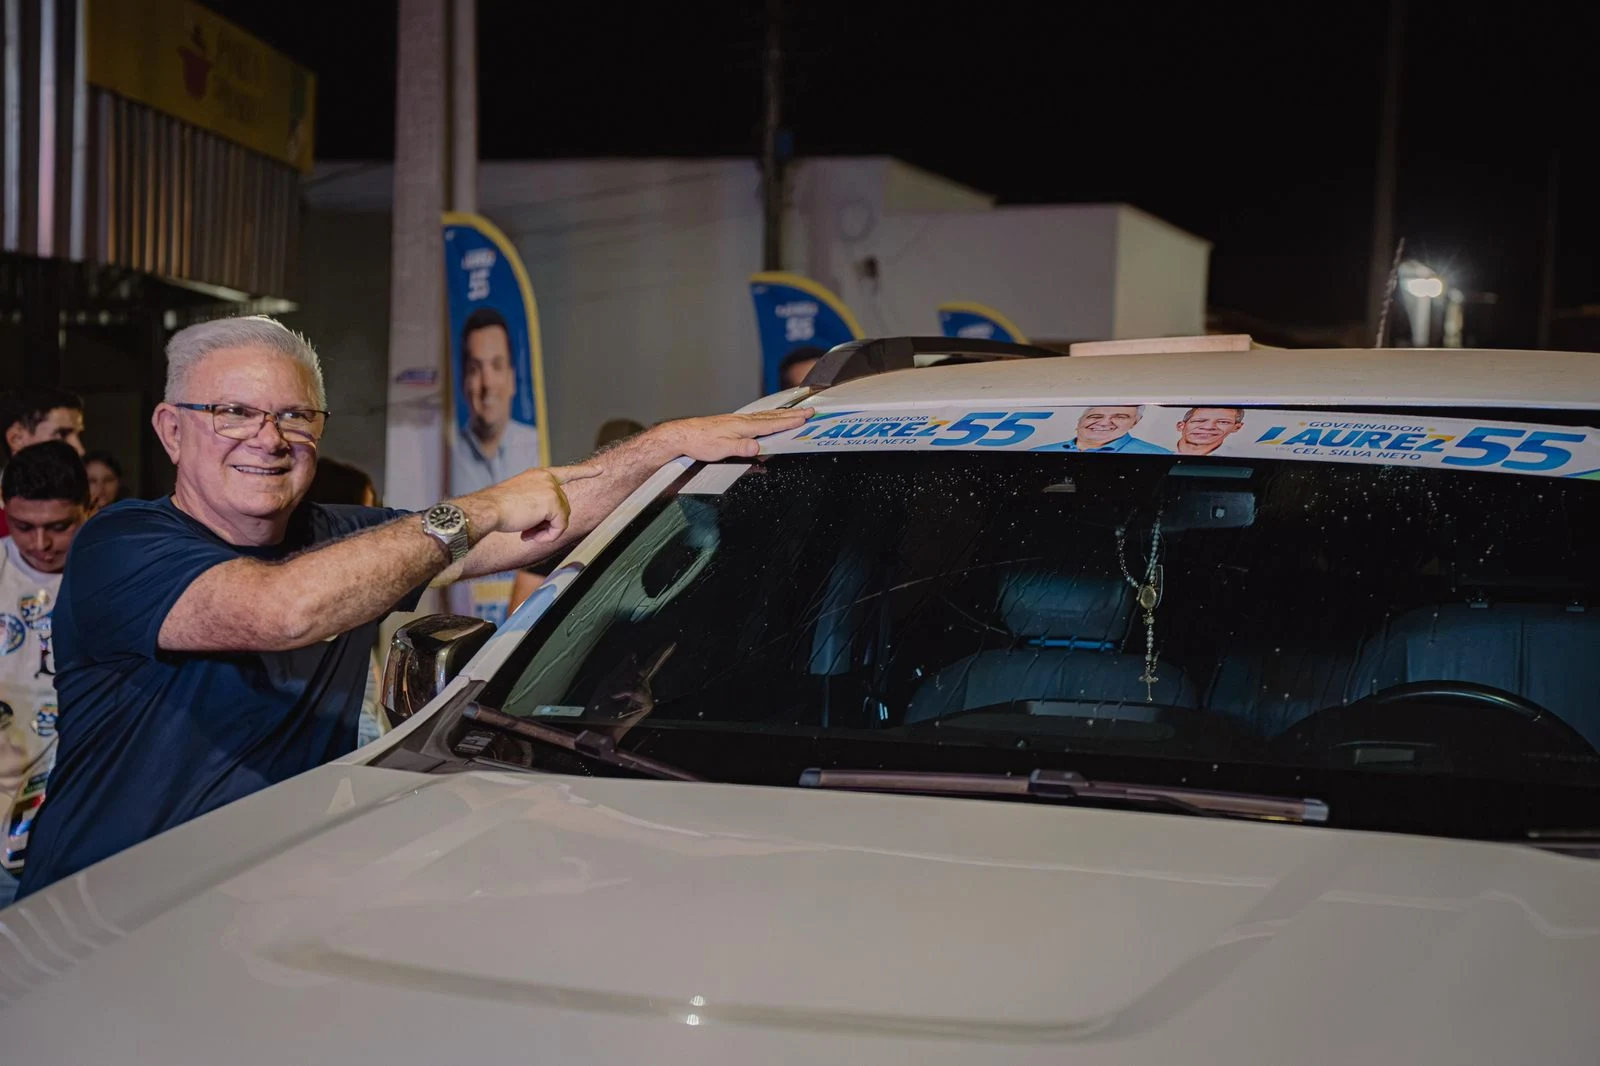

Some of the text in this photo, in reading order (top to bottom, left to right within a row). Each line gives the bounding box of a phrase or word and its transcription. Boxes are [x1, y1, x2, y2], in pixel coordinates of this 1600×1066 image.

[839, 415, 929, 424] GOVERNADOR
[1308, 420, 1424, 433] GOVERNADOR
[791, 412, 1054, 447] LAUREZ 55
[844, 438, 881, 446] SILVA
[1254, 426, 1587, 471] LAUREZ 55
[1292, 446, 1324, 456] CEL.
[1328, 448, 1372, 458] SILVA
[1380, 450, 1422, 461] NETO
